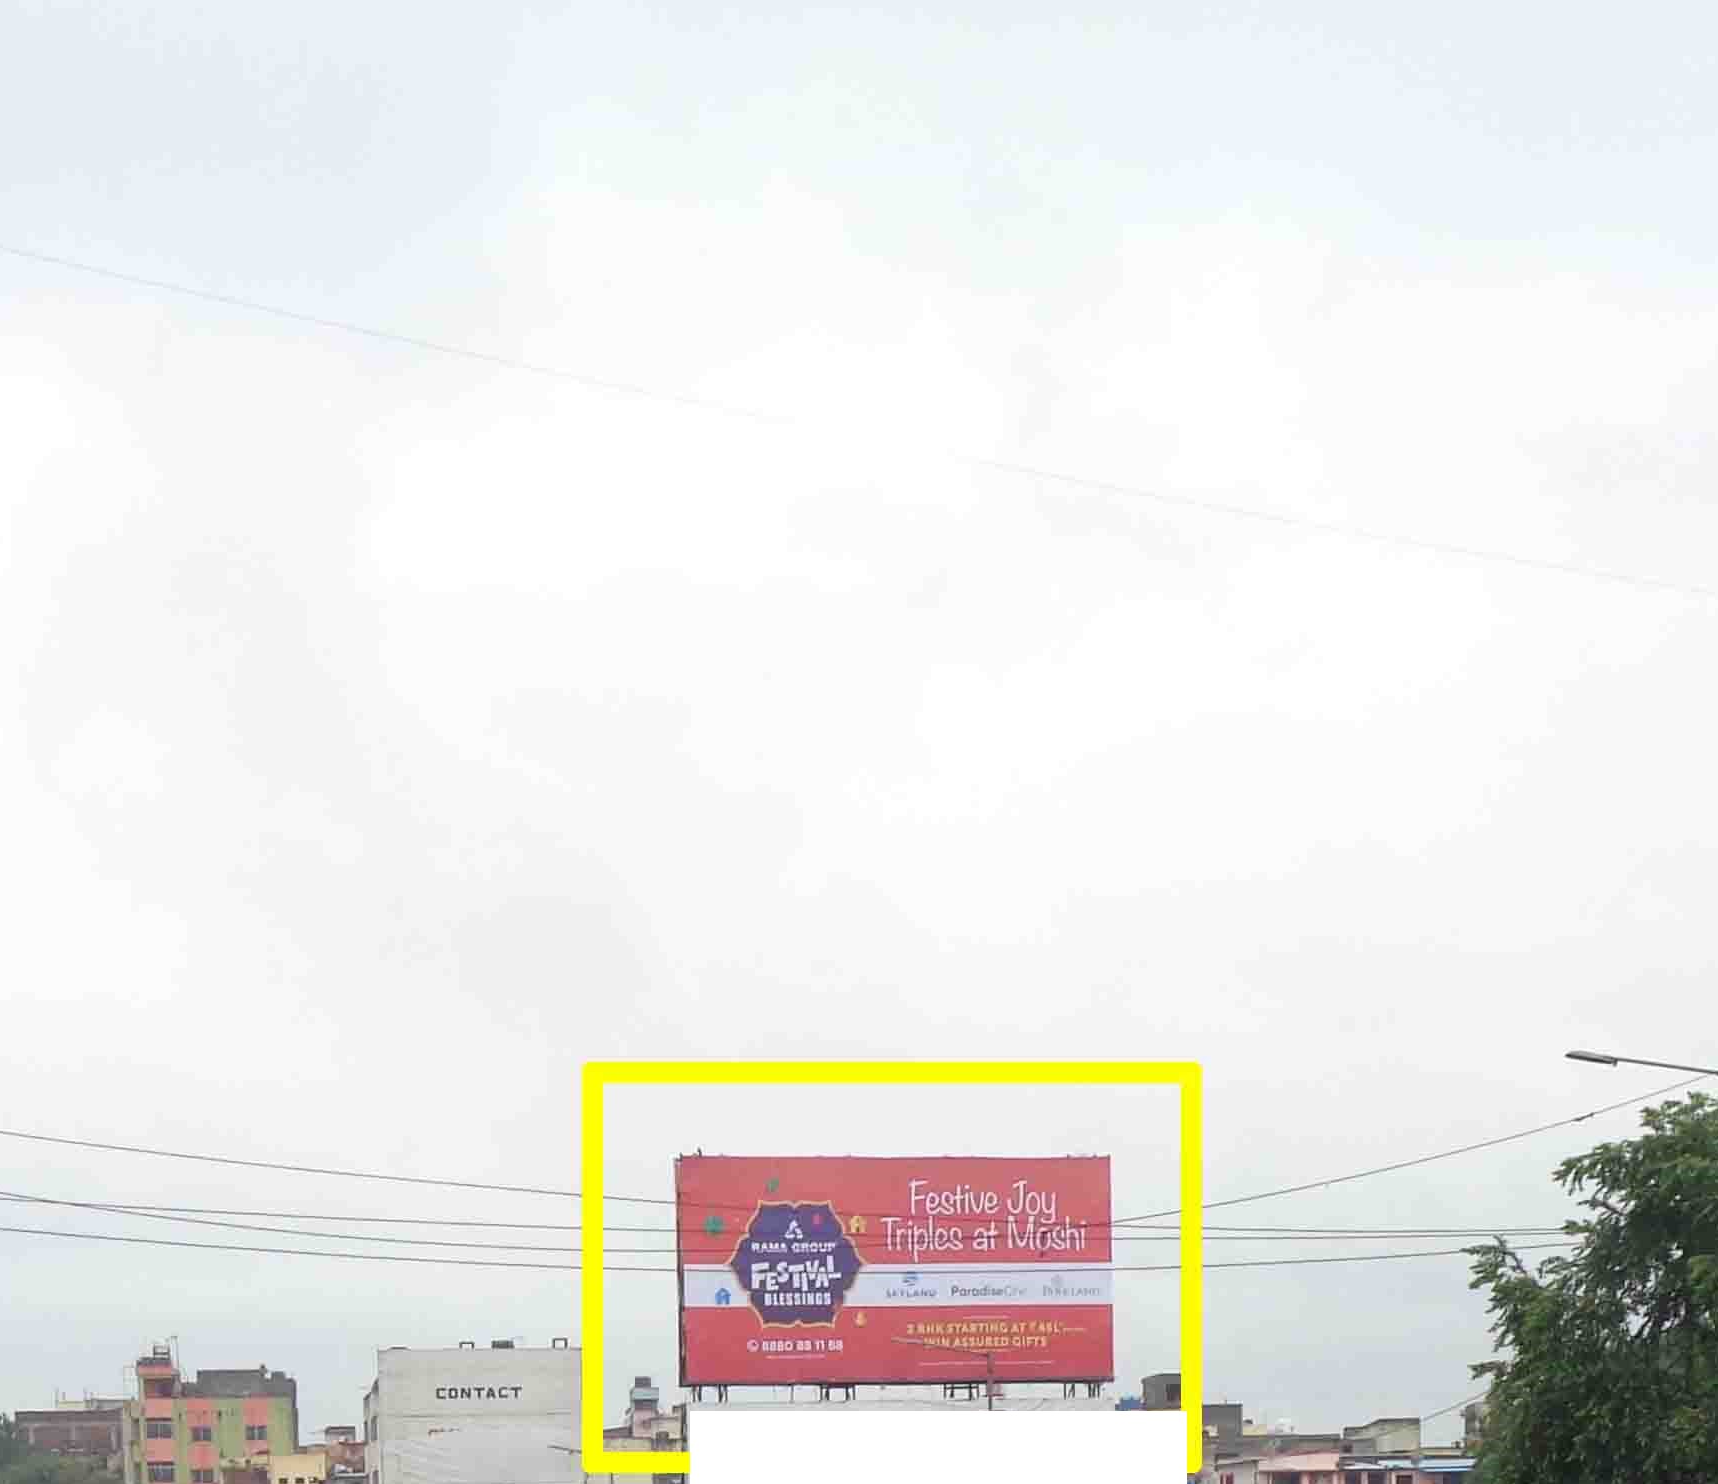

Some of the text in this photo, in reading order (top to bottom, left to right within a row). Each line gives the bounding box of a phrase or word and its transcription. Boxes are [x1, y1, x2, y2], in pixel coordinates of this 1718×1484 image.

[909, 1178, 1057, 1224] Festive Joy
[880, 1215, 1088, 1263] Triples at Moshi
[751, 1242, 836, 1254] RAMA GROUP
[750, 1255, 842, 1292] FESTIVAL
[764, 1292, 832, 1306] BLESSINGS
[947, 1322, 1007, 1334] STARTING
[1011, 1322, 1026, 1333] AT
[954, 1336, 1008, 1347] ASSURED
[1012, 1335, 1047, 1347] GIFTS
[435, 1386, 523, 1400] CONTACT
